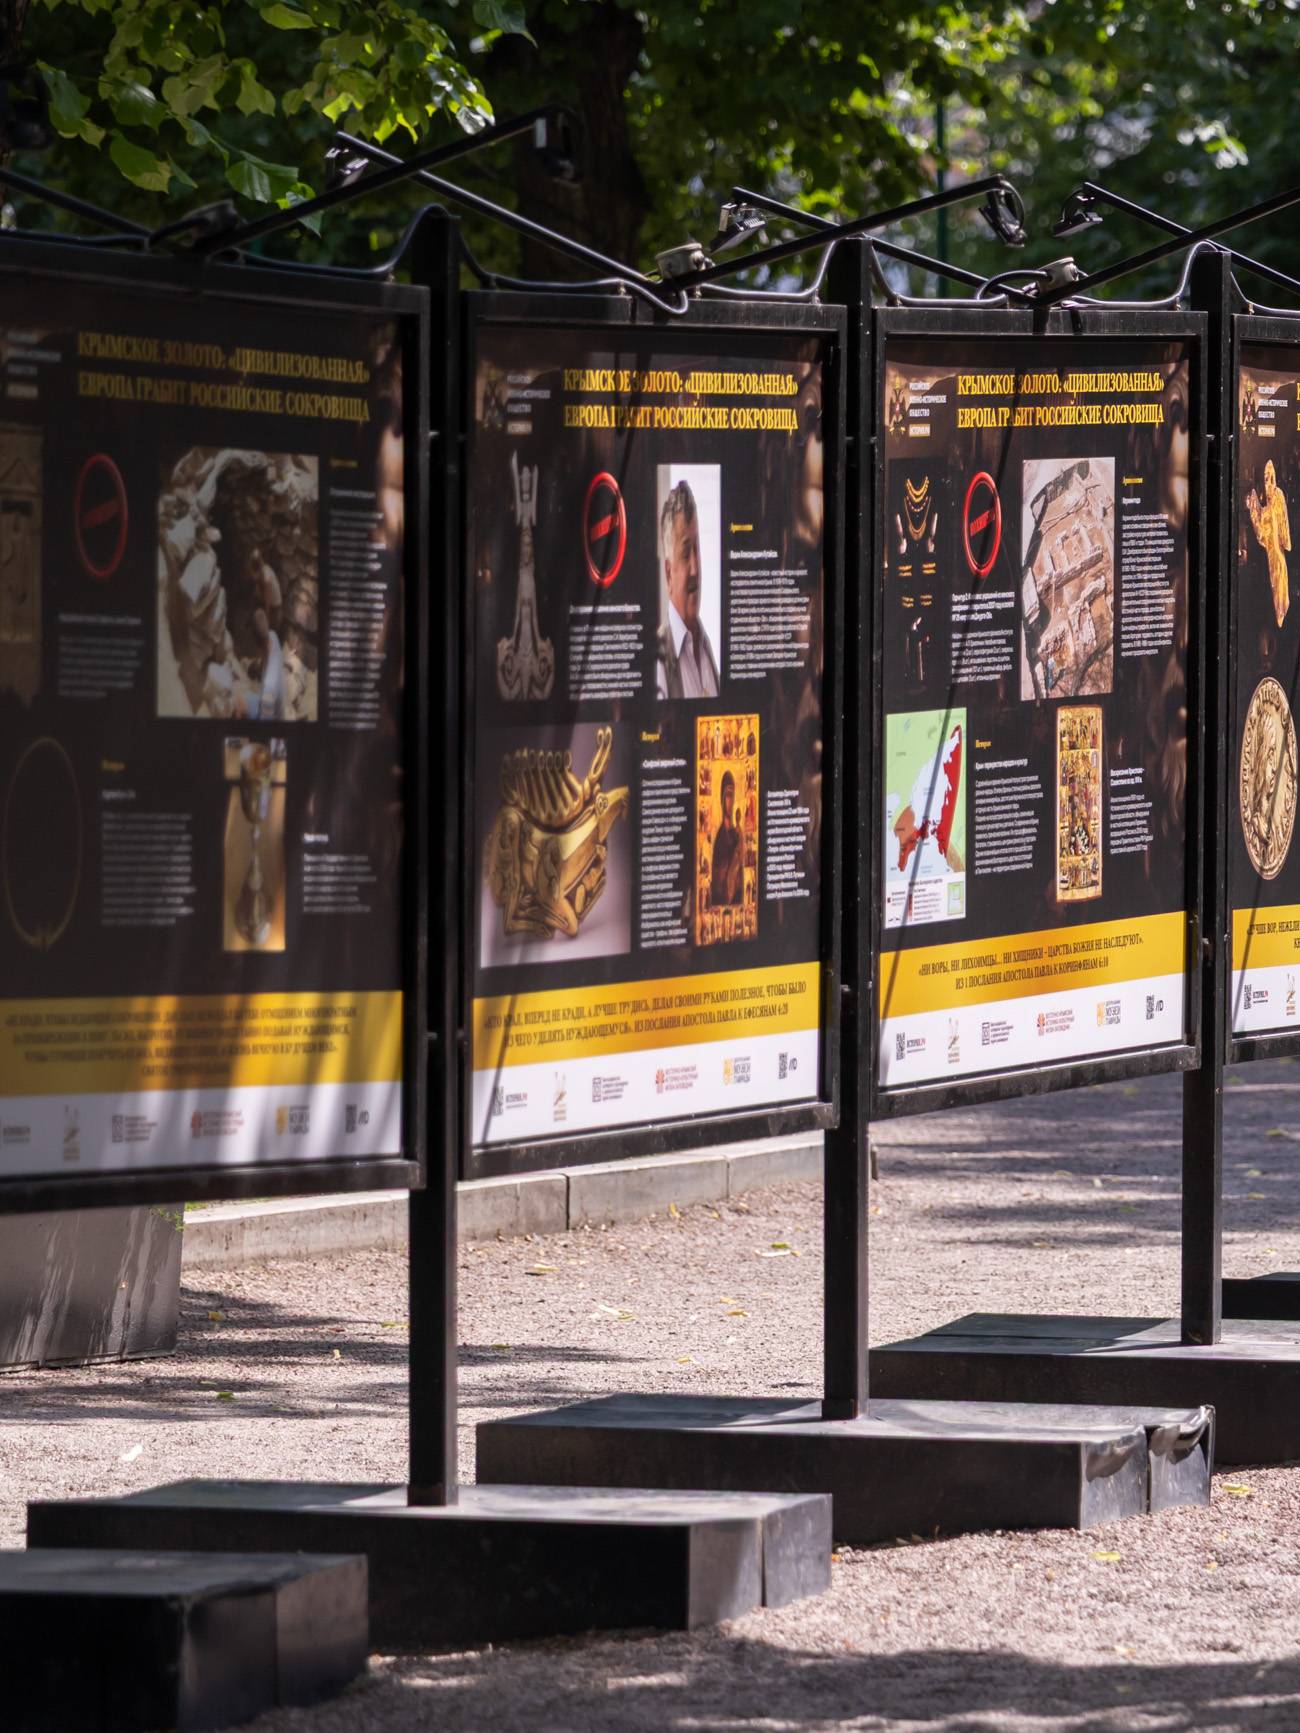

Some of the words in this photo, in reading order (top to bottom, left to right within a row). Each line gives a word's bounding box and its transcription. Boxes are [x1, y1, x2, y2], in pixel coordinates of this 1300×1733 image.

[731, 406, 799, 436] СОКРОВИЩА
[958, 408, 997, 429] ЕВРОПА
[1103, 403, 1165, 428] СОКРОВИЩА
